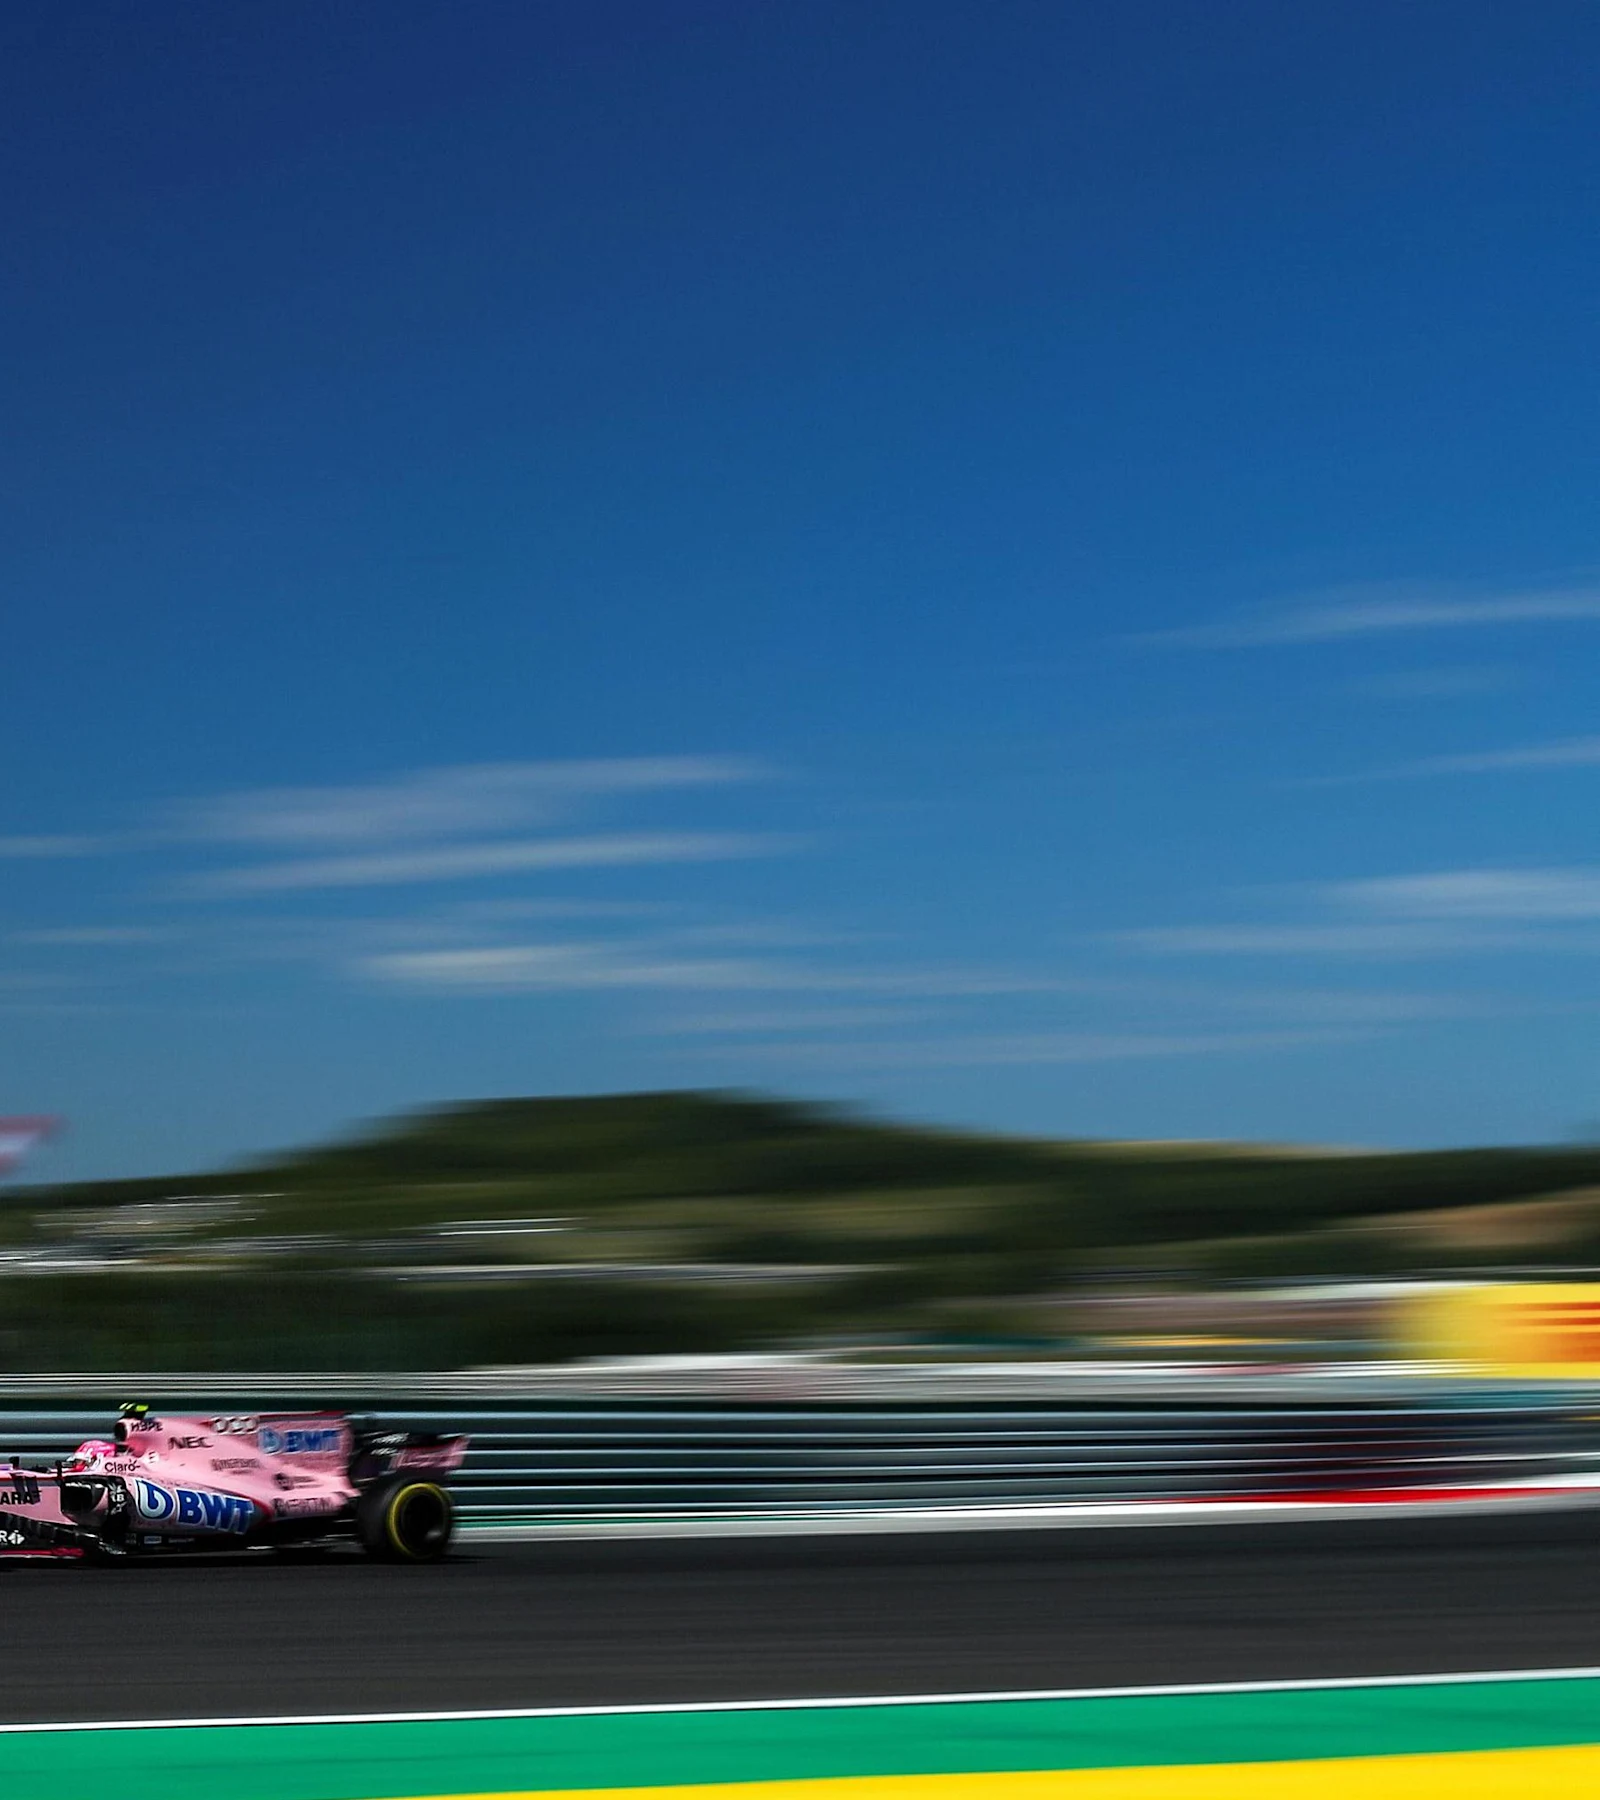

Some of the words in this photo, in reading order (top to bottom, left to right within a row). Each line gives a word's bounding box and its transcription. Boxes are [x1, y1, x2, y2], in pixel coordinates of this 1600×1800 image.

[168, 1436, 213, 1450] NEC
[104, 1459, 140, 1473] Claro
[176, 1488, 254, 1535] BWT
